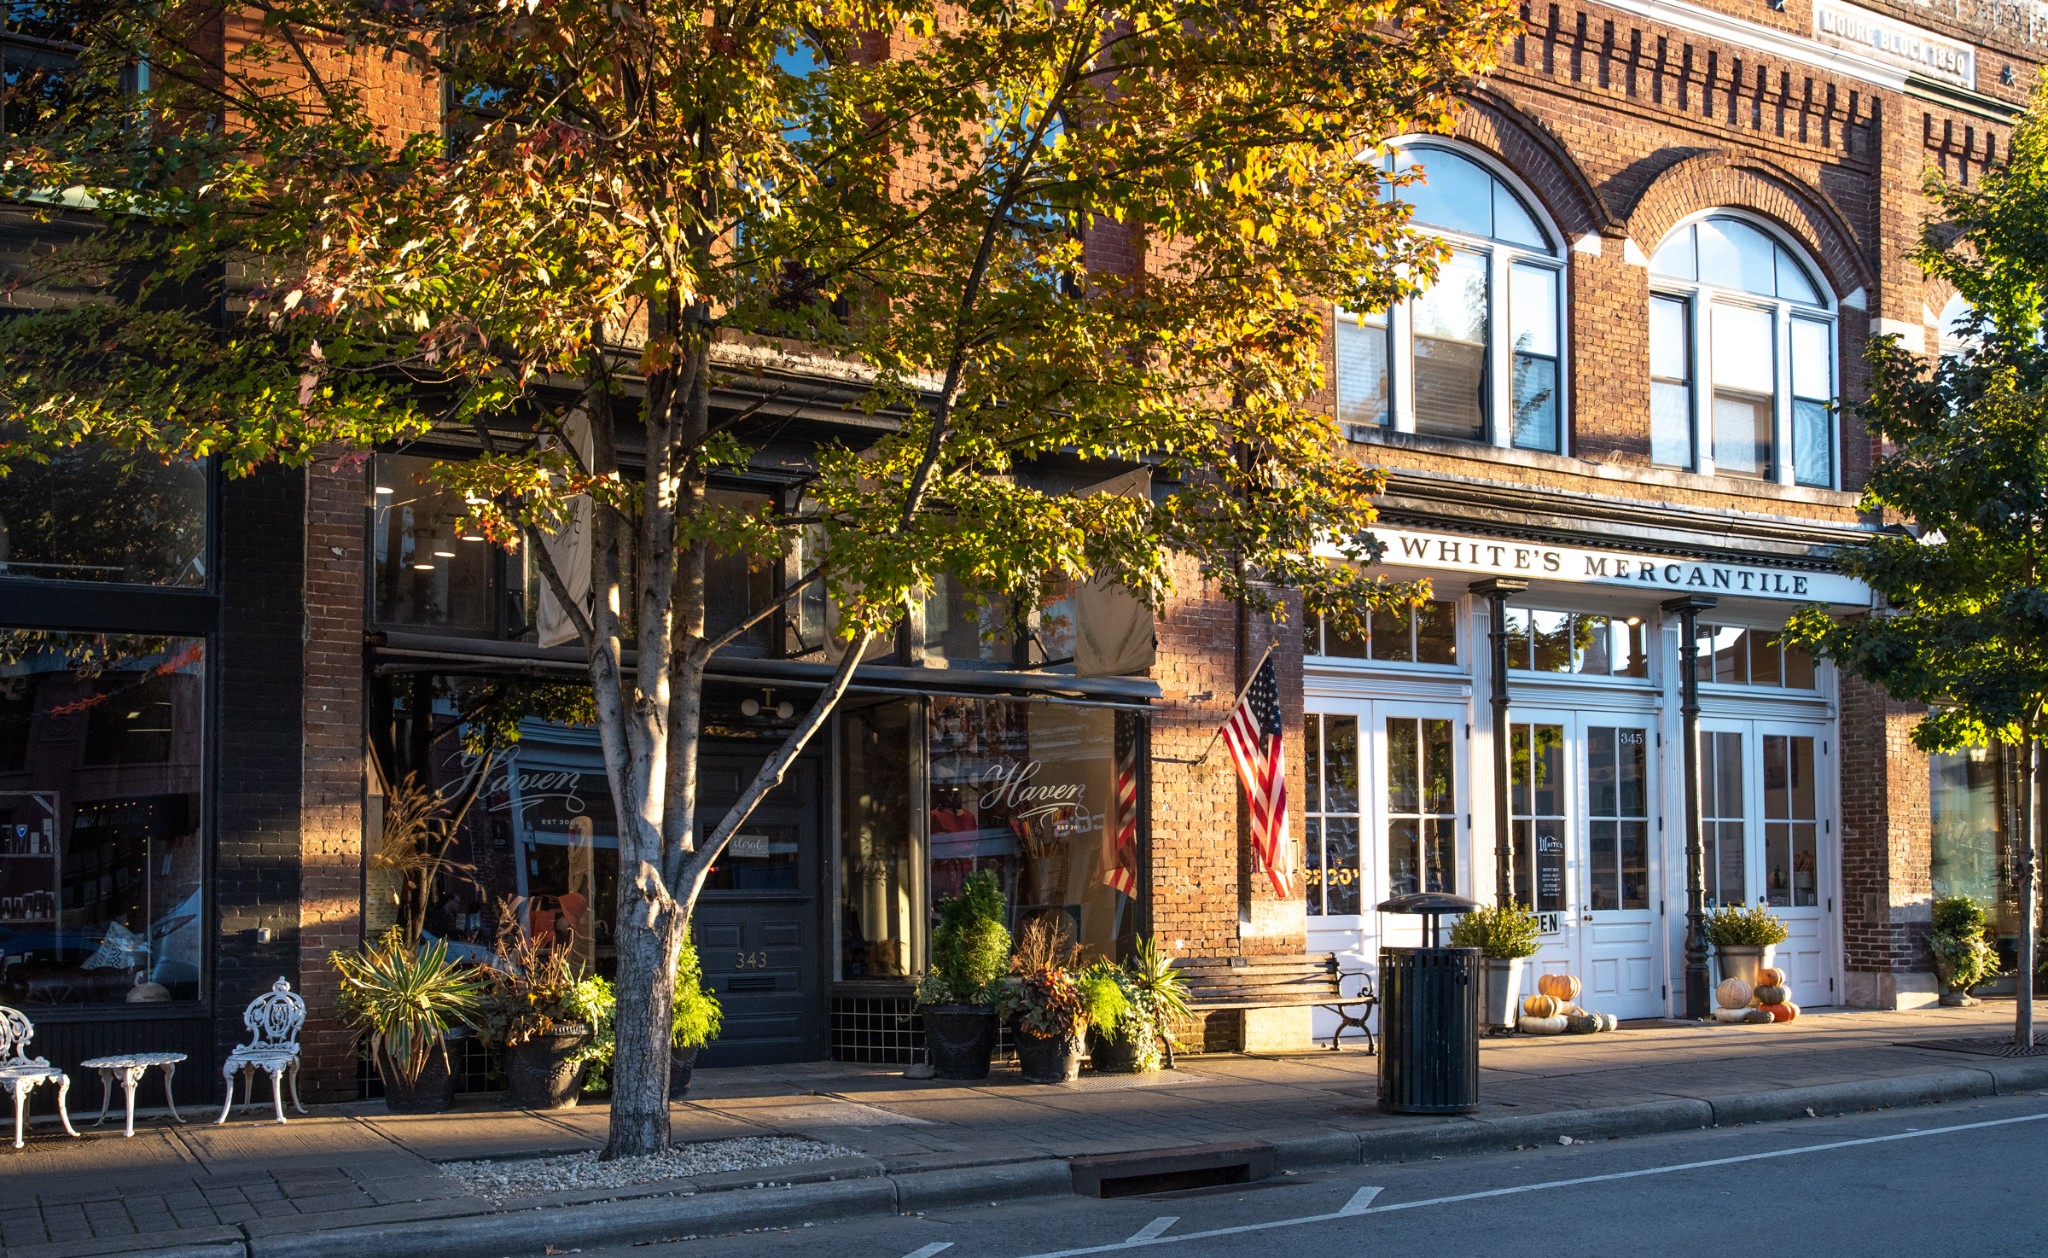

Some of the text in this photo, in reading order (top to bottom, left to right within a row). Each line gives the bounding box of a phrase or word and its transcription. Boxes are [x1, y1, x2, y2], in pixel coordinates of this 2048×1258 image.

[1822, 11, 1966, 75] MOORE BLOCK 1890
[1399, 536, 1808, 595] WHITE'S MERCANTILE
[1620, 732, 1643, 745] 345
[437, 744, 586, 814] Haven
[979, 760, 1090, 818] Haven
[735, 951, 767, 969] 343
